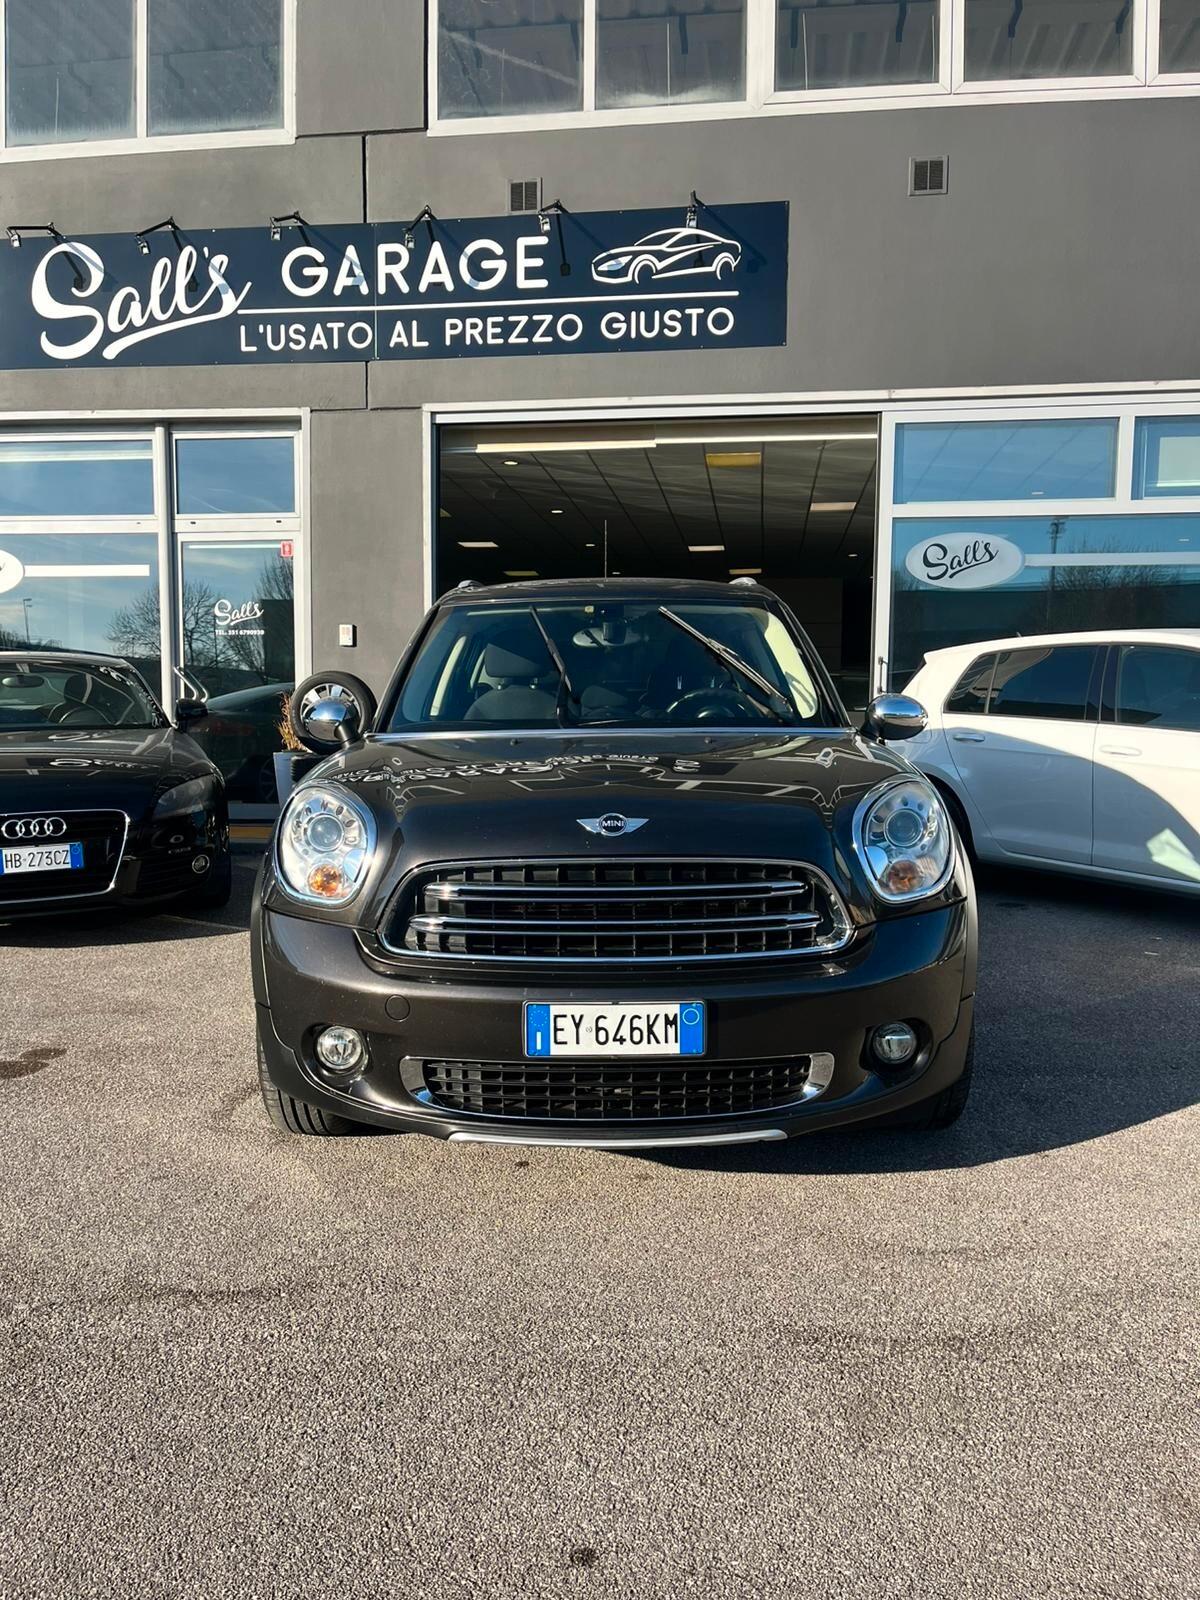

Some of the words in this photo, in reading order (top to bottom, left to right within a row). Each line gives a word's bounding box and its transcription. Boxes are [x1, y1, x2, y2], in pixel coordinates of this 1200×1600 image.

[31, 241, 252, 360] Sall's
[281, 235, 550, 298] GARAGE
[240, 321, 373, 352] L'USATO
[389, 320, 430, 348] AL
[444, 313, 584, 346] PREZZO
[600, 306, 735, 340] GIUSTO
[922, 540, 999, 581] Sall's
[214, 599, 264, 626] Sall's
[553, 1013, 584, 1045] EY
[594, 1012, 679, 1046] 646KM
